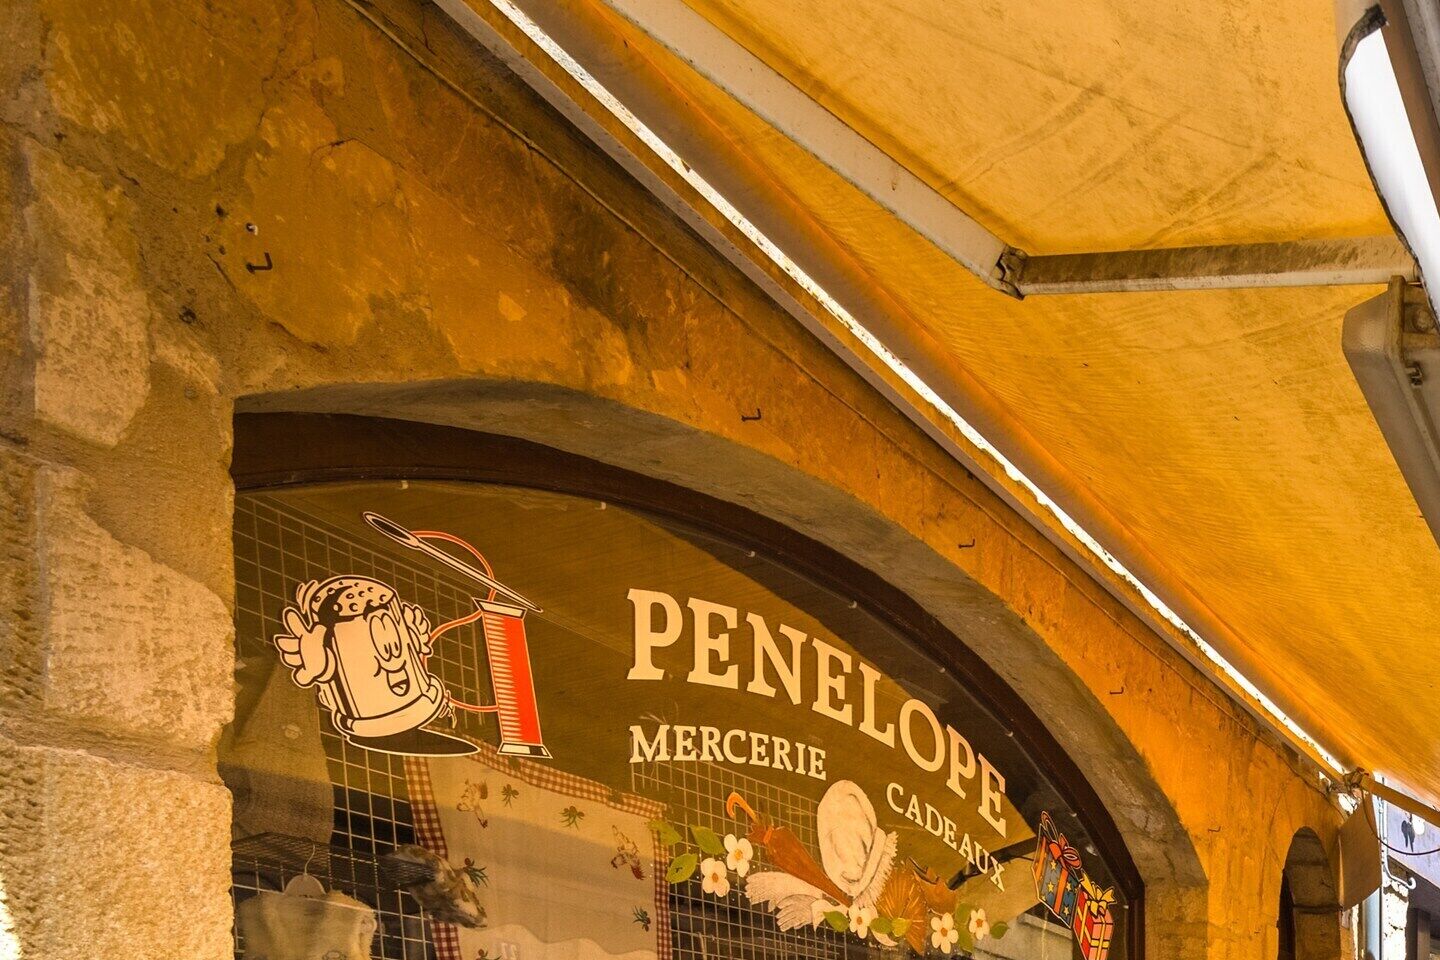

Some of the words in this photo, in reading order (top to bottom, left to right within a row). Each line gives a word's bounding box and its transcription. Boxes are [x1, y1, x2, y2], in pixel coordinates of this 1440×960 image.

[627, 588, 1006, 838] PENELOPE
[629, 724, 827, 780] MERCERIE
[886, 782, 1005, 892] CADEAUX
